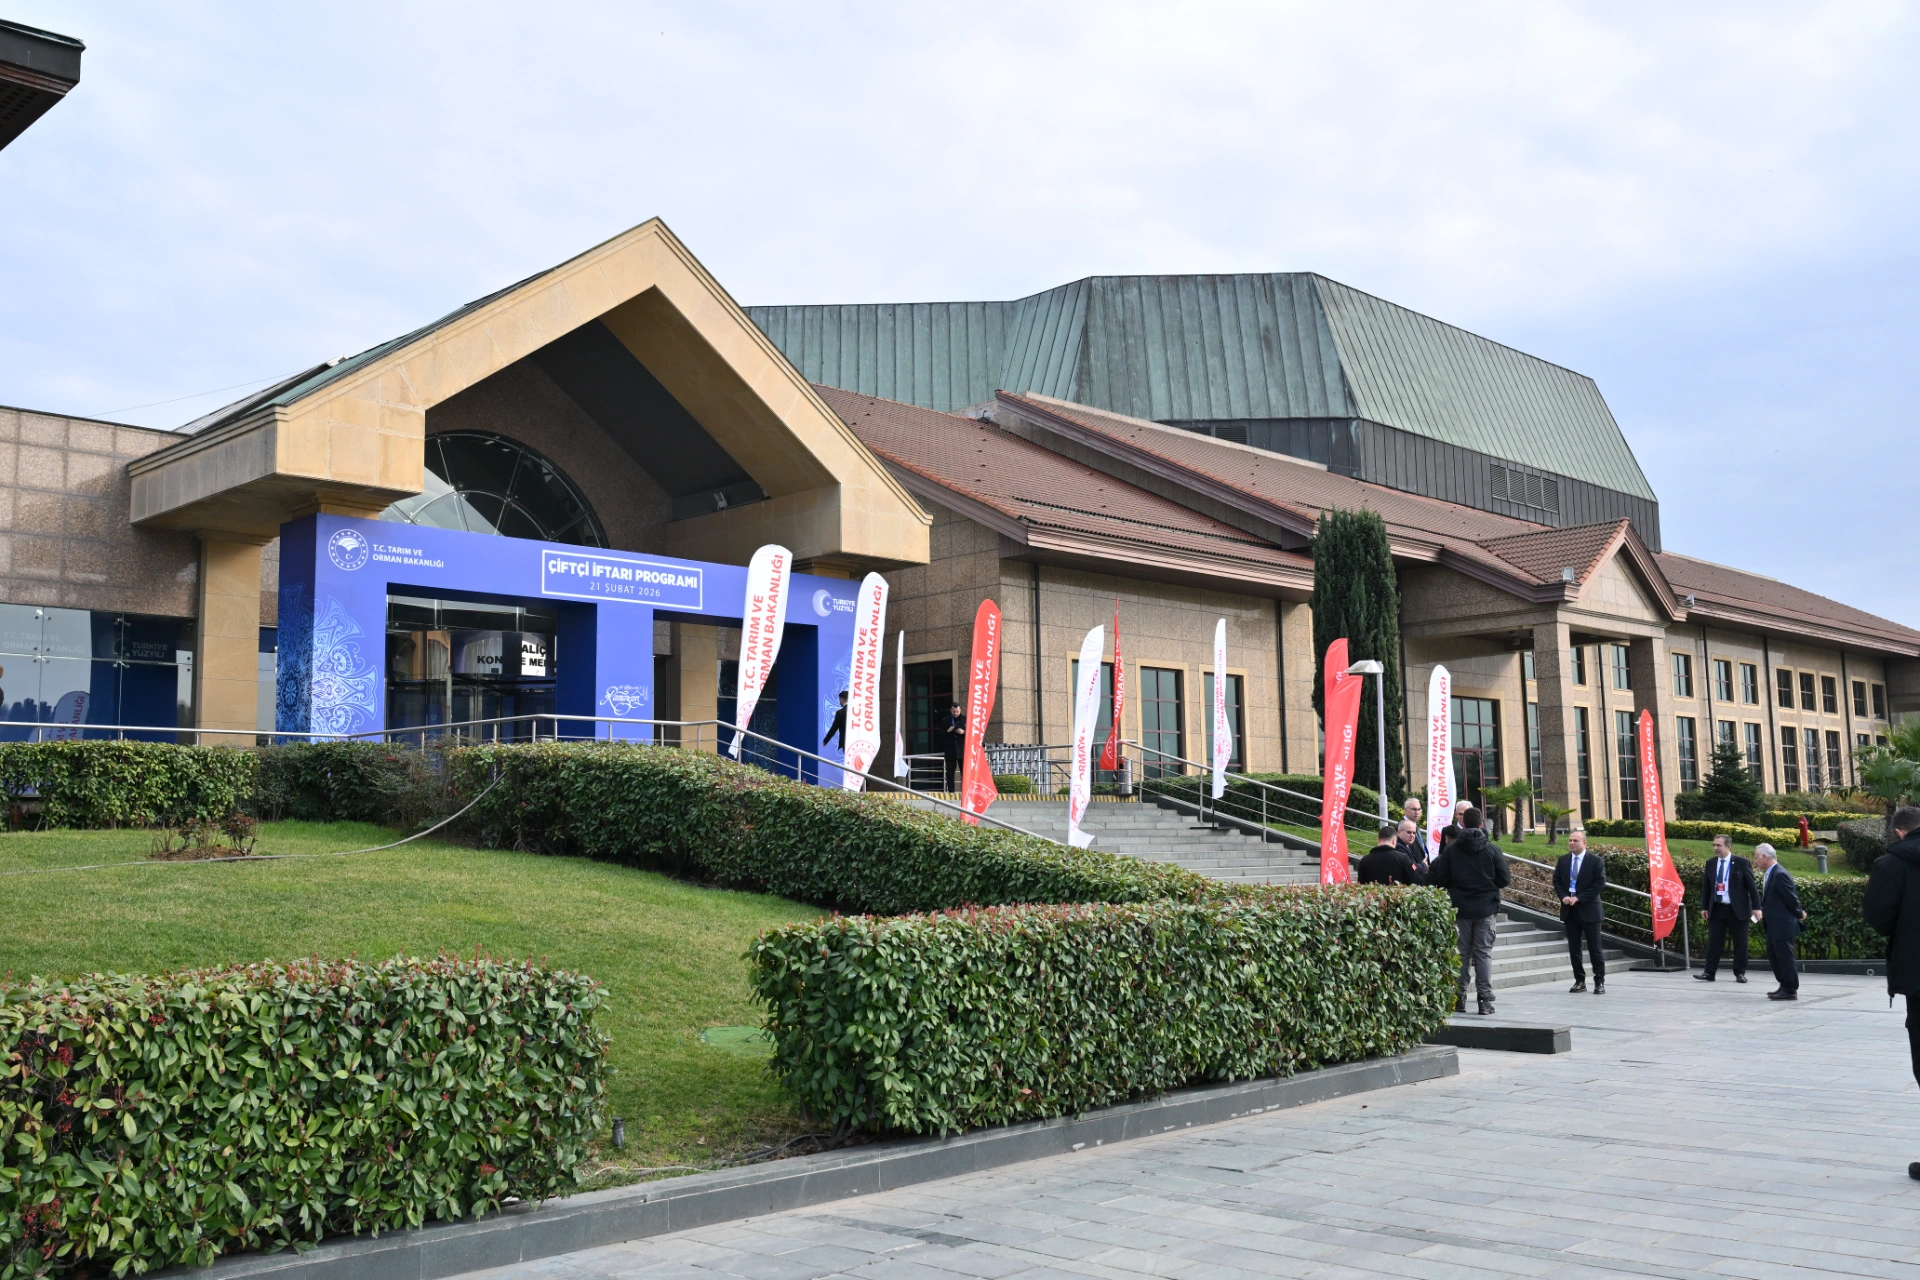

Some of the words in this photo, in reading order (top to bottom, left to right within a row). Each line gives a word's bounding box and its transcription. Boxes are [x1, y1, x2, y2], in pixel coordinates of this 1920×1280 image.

[372, 554, 402, 563] ORMAN
[403, 557, 444, 568] BAKANLIĞI
[373, 544, 386, 552] T.C.
[388, 545, 411, 555] TARIM
[548, 557, 589, 577] ÇİFTÇİ
[592, 561, 632, 581] İFTARI
[635, 569, 698, 588] PROGRAMI
[590, 581, 600, 591] 21
[605, 583, 635, 594] ŞUBAT
[638, 587, 661, 597] 2026
[752, 594, 764, 612] VE
[763, 554, 784, 634] BAKANLIĞI
[746, 617, 761, 662] TARIM
[858, 627, 868, 646] VE
[867, 585, 882, 669] BAKANLIĞI
[975, 659, 984, 680] VE
[983, 613, 996, 703] BAKANLIĞI
[744, 666, 756, 690] T.C.
[853, 650, 865, 699] TARIM
[851, 703, 862, 729] T.C.
[864, 672, 875, 732] ORMAN
[972, 684, 983, 737] TARIM
[1433, 714, 1439, 732] VE
[1430, 735, 1439, 779] TARIM
[1334, 764, 1342, 781] VE
[1438, 755, 1449, 808] ORMAN
